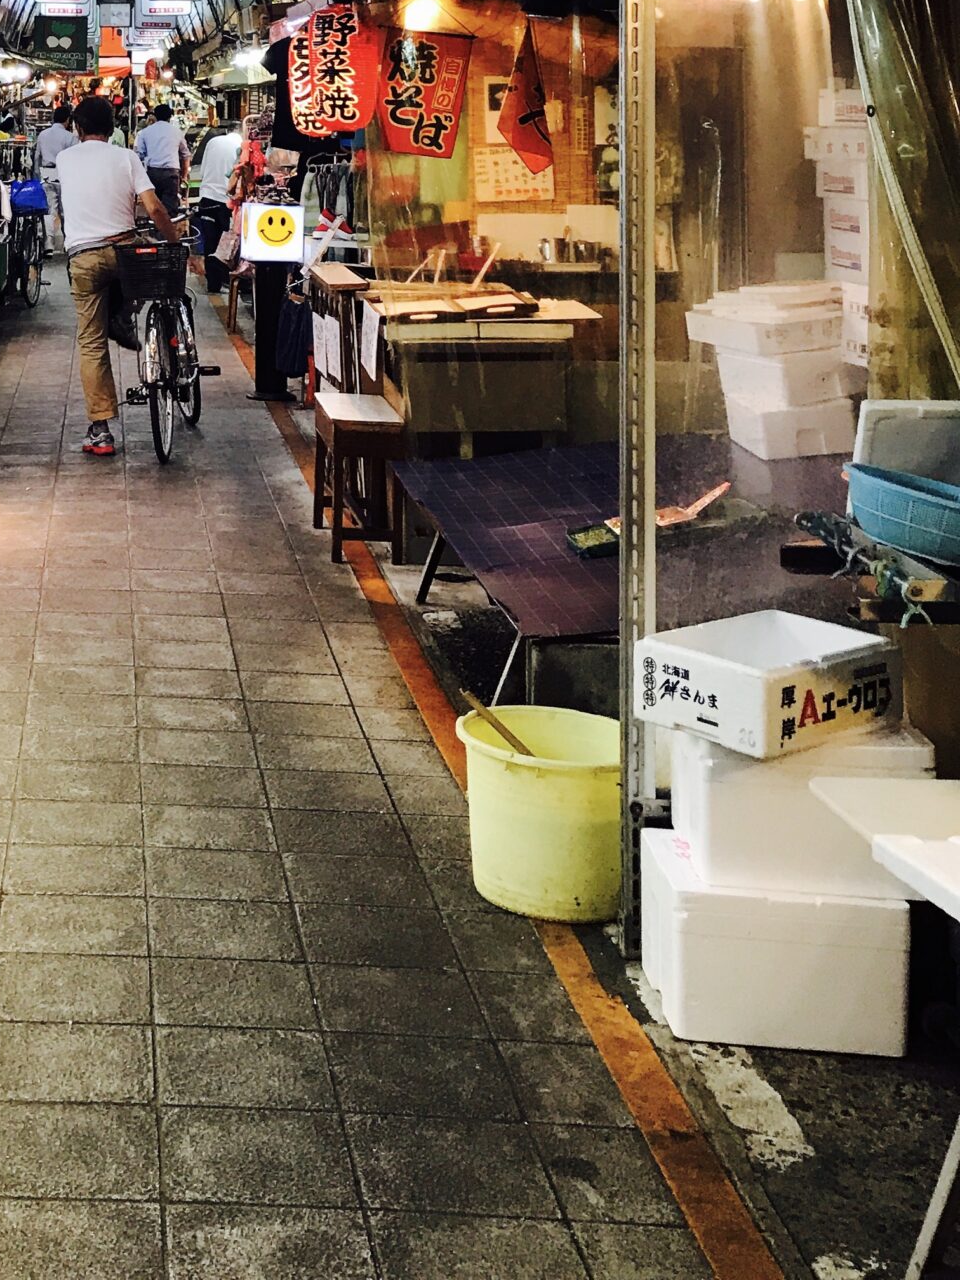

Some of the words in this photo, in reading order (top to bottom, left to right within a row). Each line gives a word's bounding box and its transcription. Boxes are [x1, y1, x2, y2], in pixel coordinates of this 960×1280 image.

[312, 13, 358, 121] 野菜焼
[662, 663, 690, 681] 北海道
[658, 678, 718, 709] 鮮さんま
